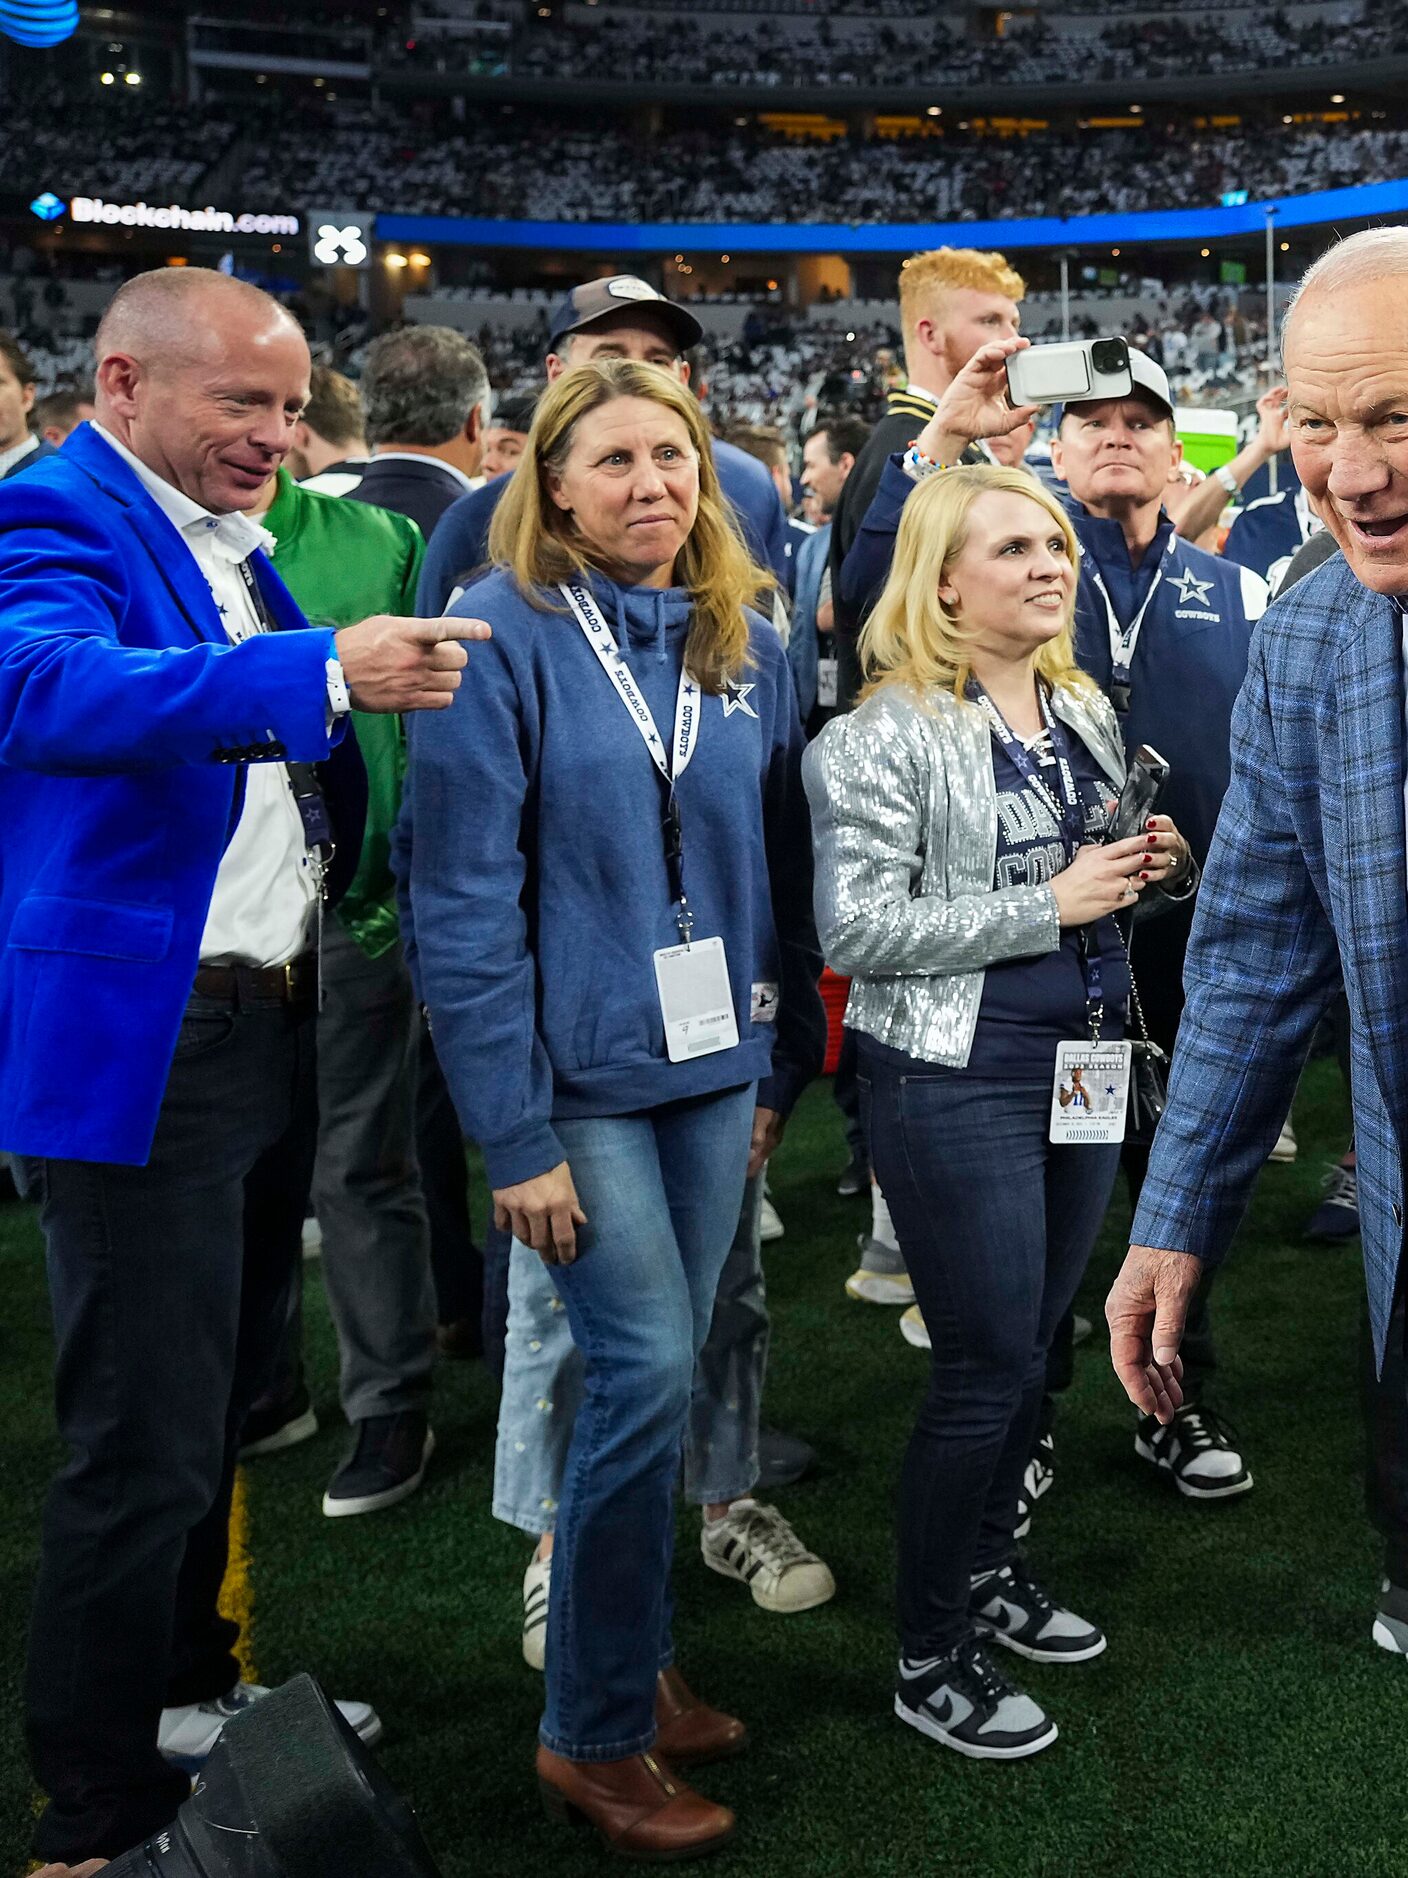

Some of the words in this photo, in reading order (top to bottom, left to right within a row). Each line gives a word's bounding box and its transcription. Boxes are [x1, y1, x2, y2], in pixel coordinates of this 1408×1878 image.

[71, 196, 299, 235] Blockchain.com
[1174, 609, 1221, 623] COWBOYS
[614, 669, 649, 723] COWBOYS
[679, 705, 693, 758] COWBOYS
[1058, 757, 1078, 806] COWBOYS
[1064, 1053, 1090, 1063] DALLAS
[1091, 1053, 1124, 1063] COWBOYS
